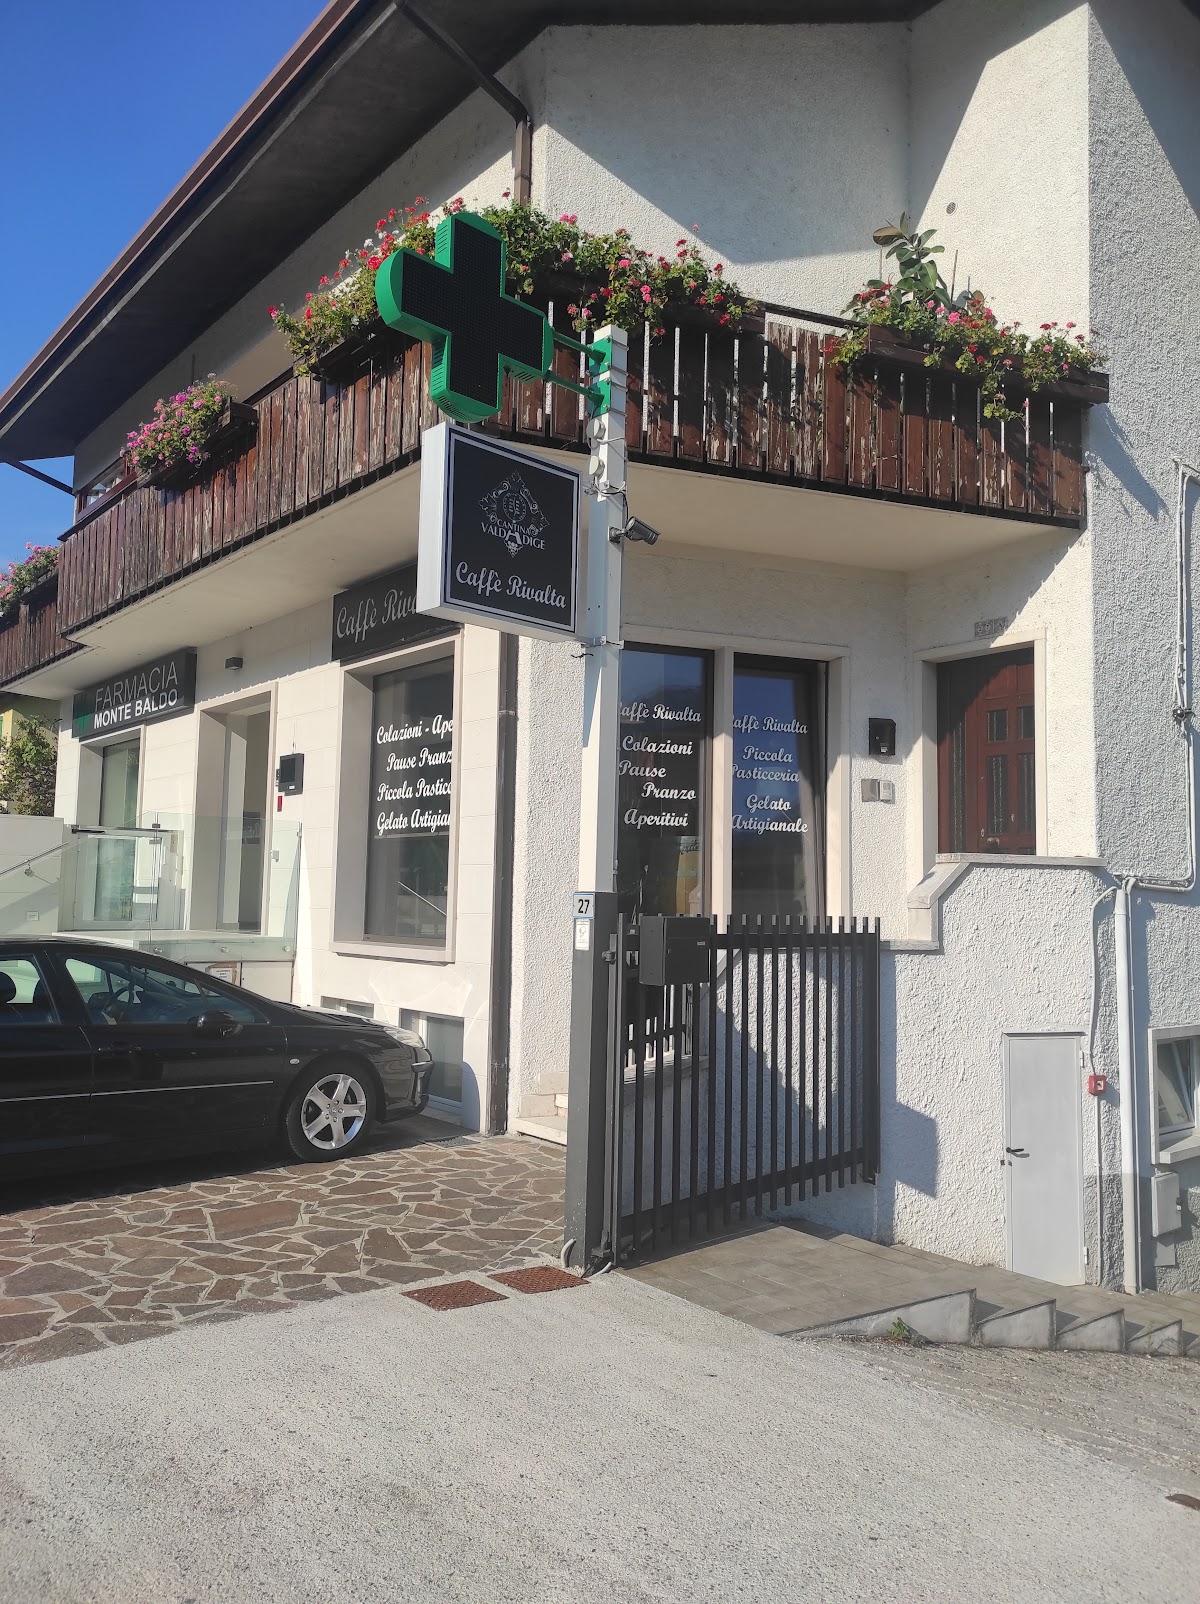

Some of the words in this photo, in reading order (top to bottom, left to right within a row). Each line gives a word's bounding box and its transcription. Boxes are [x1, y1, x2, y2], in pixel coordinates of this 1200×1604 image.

[497, 519, 531, 536] CANTINA
[456, 561, 502, 597] Caffè
[507, 575, 567, 609] Rivalta
[336, 598, 377, 643] Caffè
[95, 661, 178, 712] FARMACIA
[94, 703, 132, 729] MONTE
[135, 688, 178, 717] BALDO
[619, 701, 649, 721] affè
[652, 703, 702, 722] Rivalta
[376, 720, 423, 744] Colazioni
[733, 714, 760, 734] affè
[762, 716, 808, 734] Rivalta
[622, 735, 693, 755] Colazioni
[742, 745, 793, 763] Piccola
[386, 752, 417, 772] Pause
[618, 759, 667, 778] Pause
[376, 780, 414, 801] Piccola
[641, 781, 696, 800] Pranzo
[746, 794, 792, 814] Gelato
[376, 811, 408, 836] Gelato
[623, 808, 689, 830] Aperitivi
[732, 814, 809, 835] Artigianale
[578, 899, 590, 914] 27
